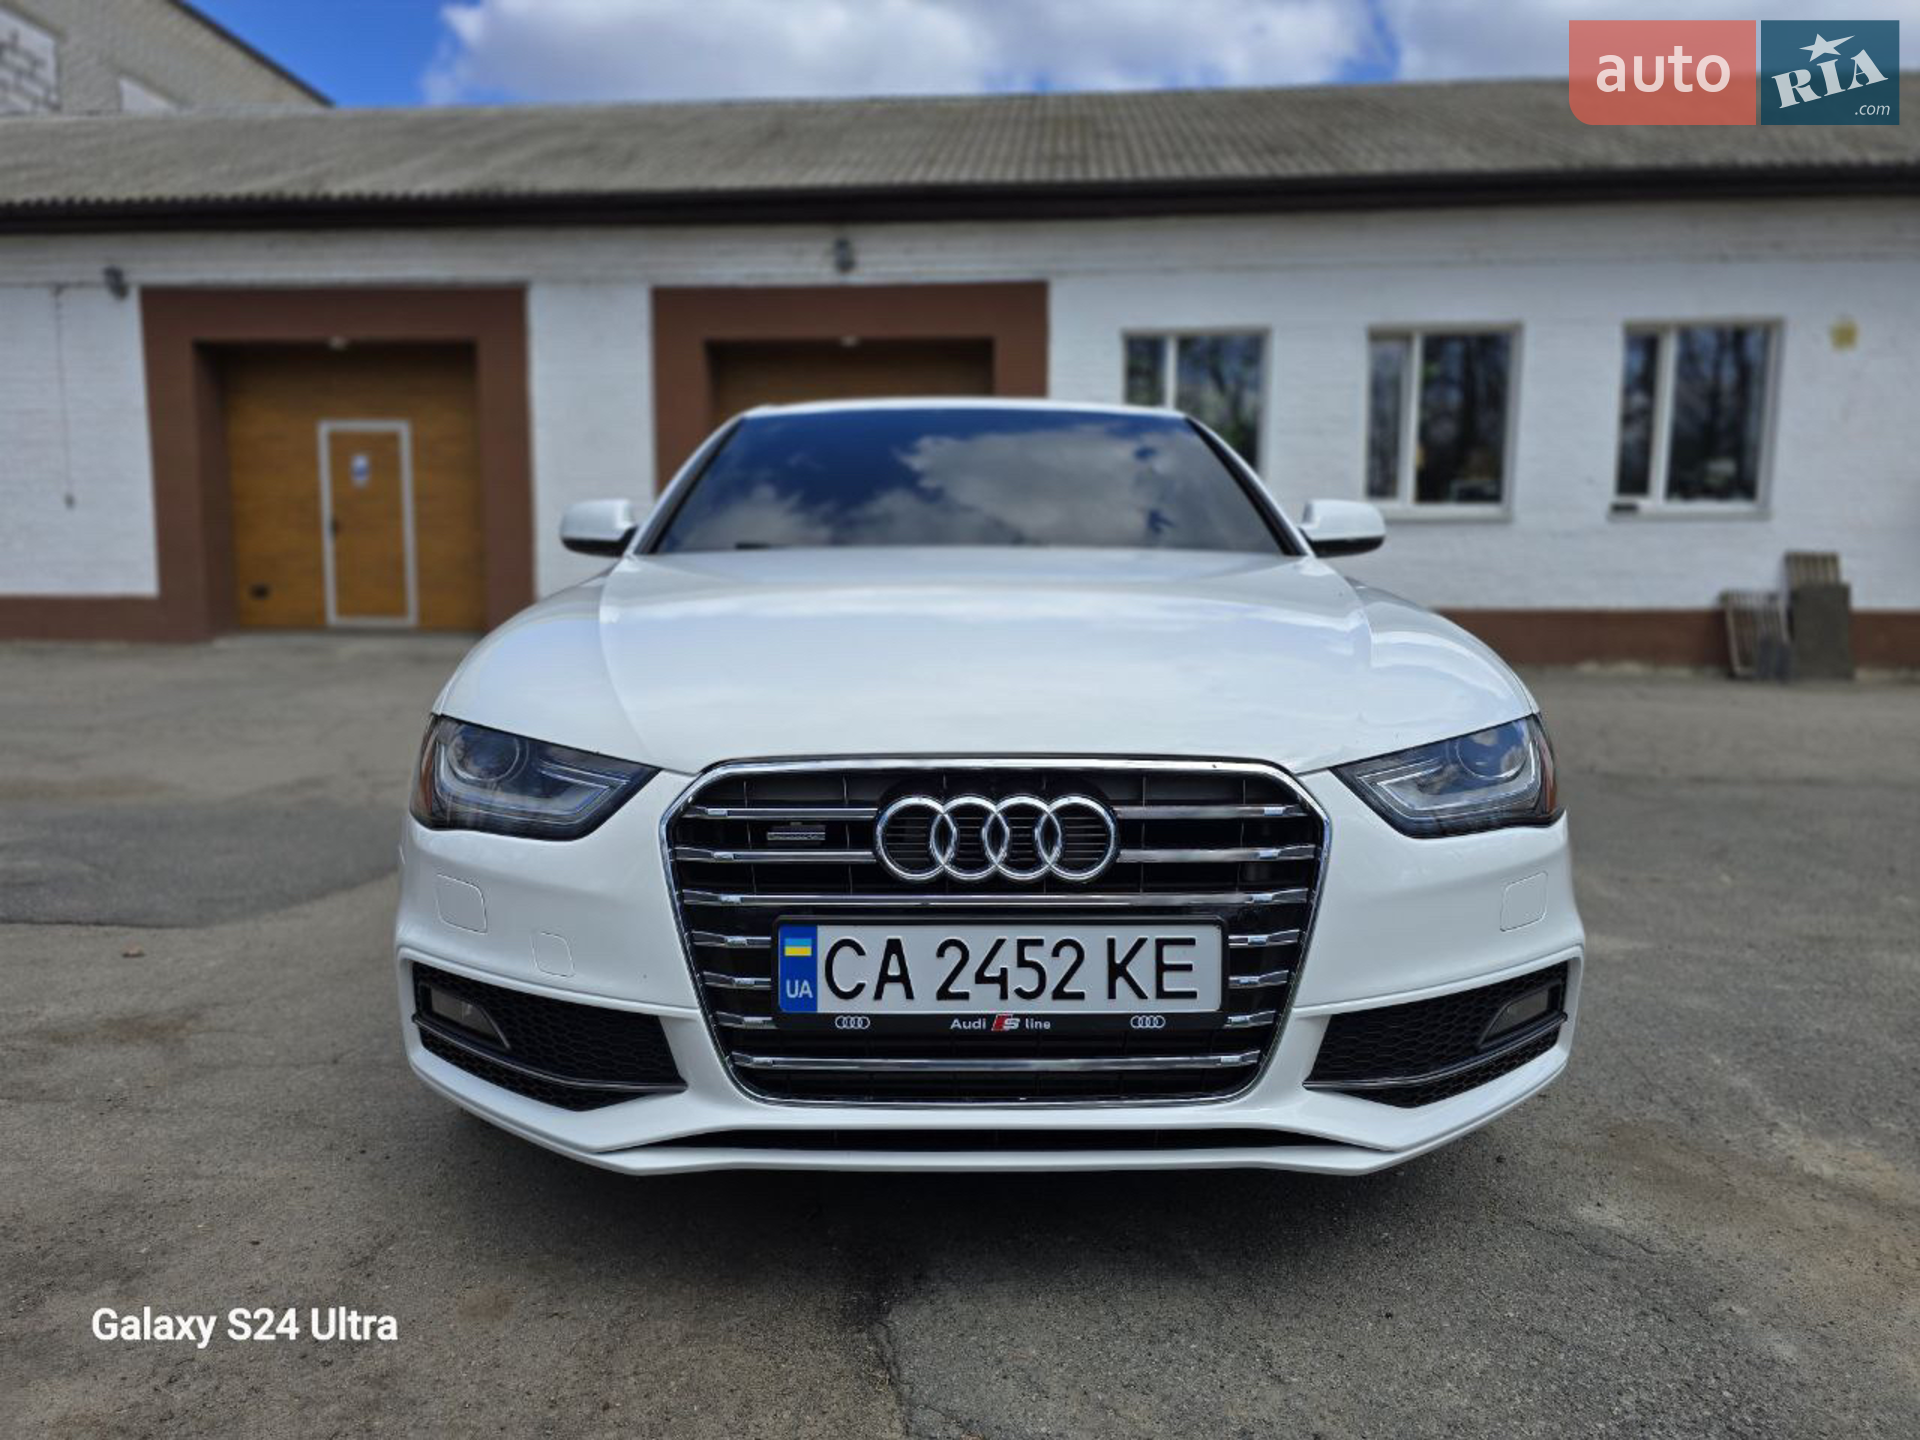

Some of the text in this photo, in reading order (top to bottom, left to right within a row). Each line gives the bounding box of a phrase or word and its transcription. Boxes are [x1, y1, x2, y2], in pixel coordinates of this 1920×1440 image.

[824, 937, 1198, 1002] CA 2452 KE
[785, 979, 813, 999] UA
[950, 1018, 987, 1031] Audi
[1025, 1018, 1051, 1031] line
